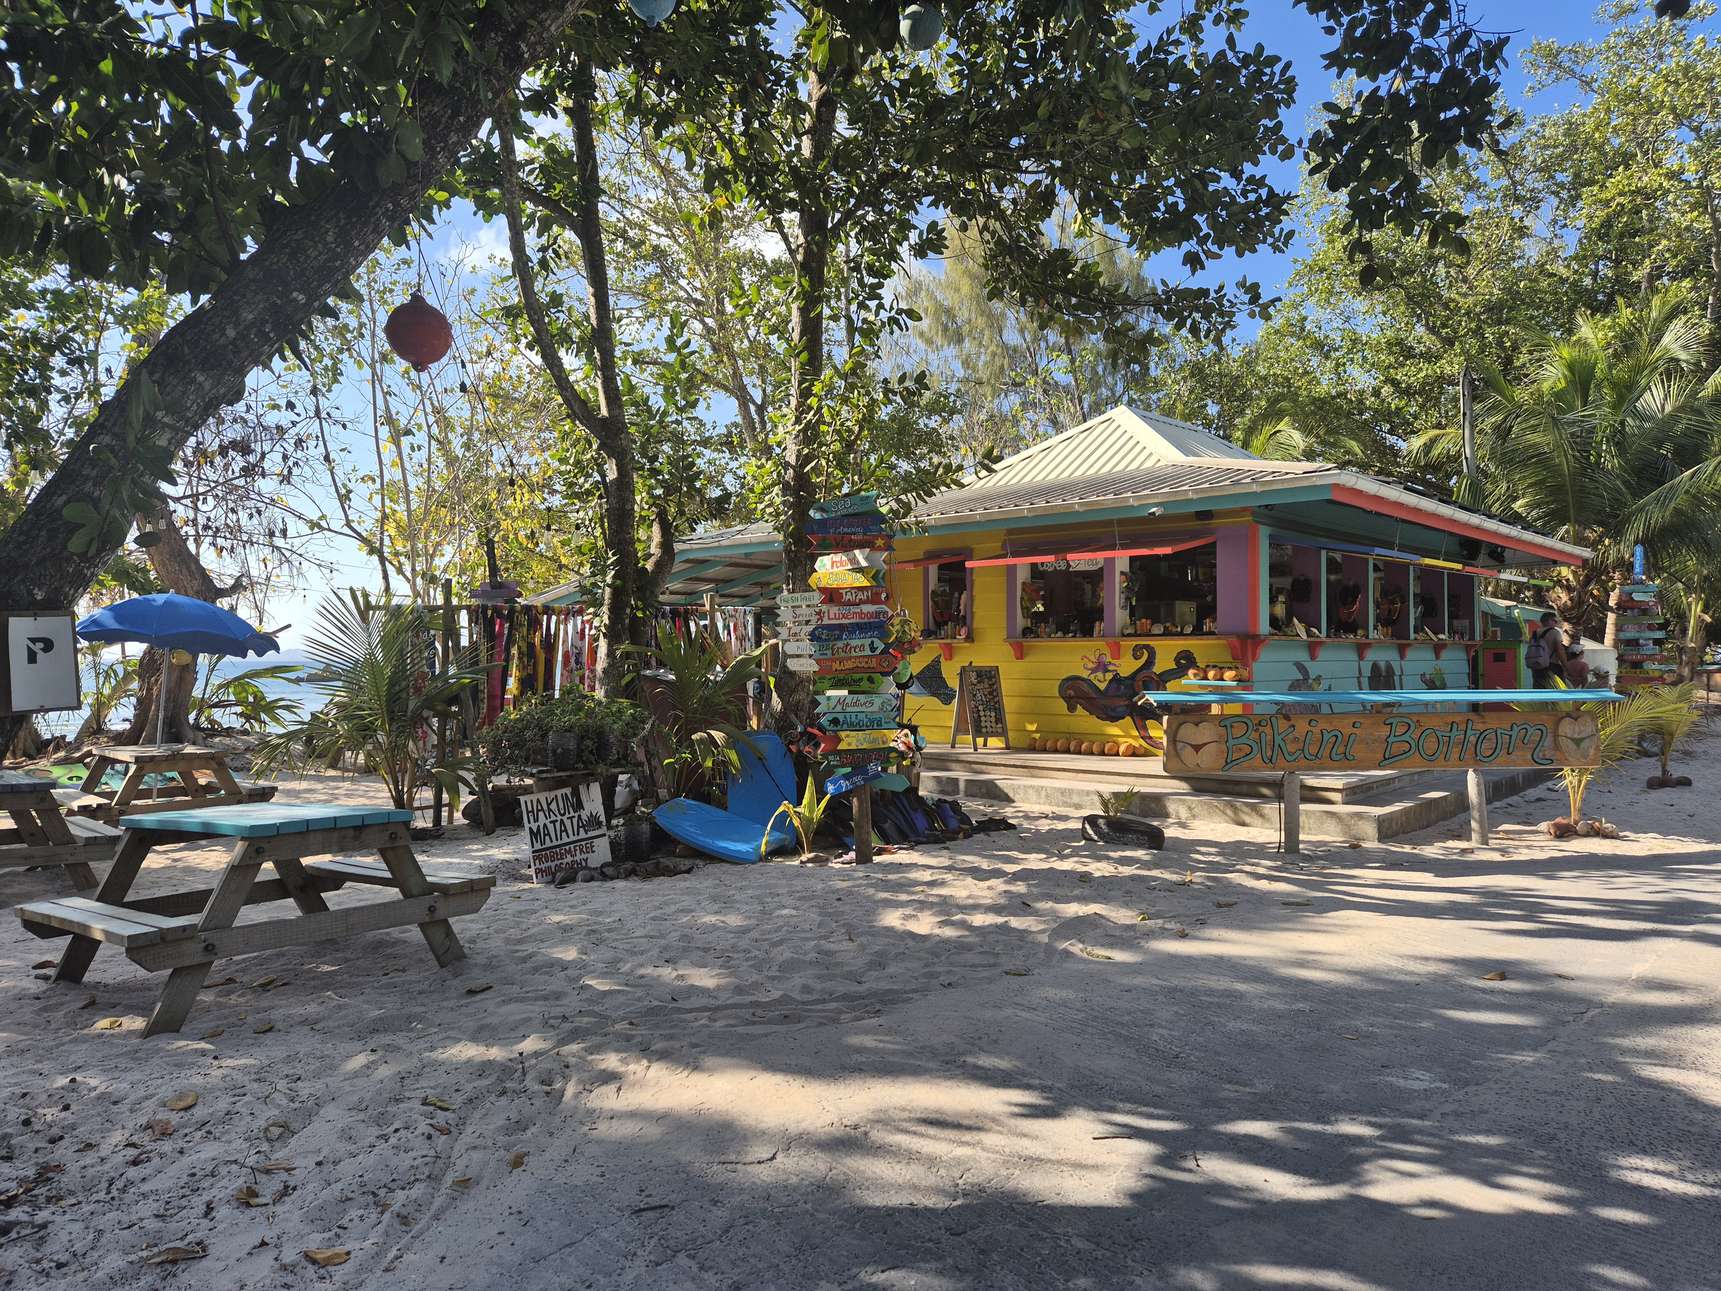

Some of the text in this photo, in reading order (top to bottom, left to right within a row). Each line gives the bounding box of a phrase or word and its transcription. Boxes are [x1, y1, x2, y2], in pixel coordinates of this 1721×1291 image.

[831, 498, 852, 511] Sea
[839, 588, 871, 602] JAPAN
[832, 642, 866, 655] Eritrea
[832, 697, 875, 711] Maldives
[1220, 716, 1554, 772] Bikini Bottom
[525, 792, 585, 824] HAKUNA
[529, 814, 588, 849] MATATA
